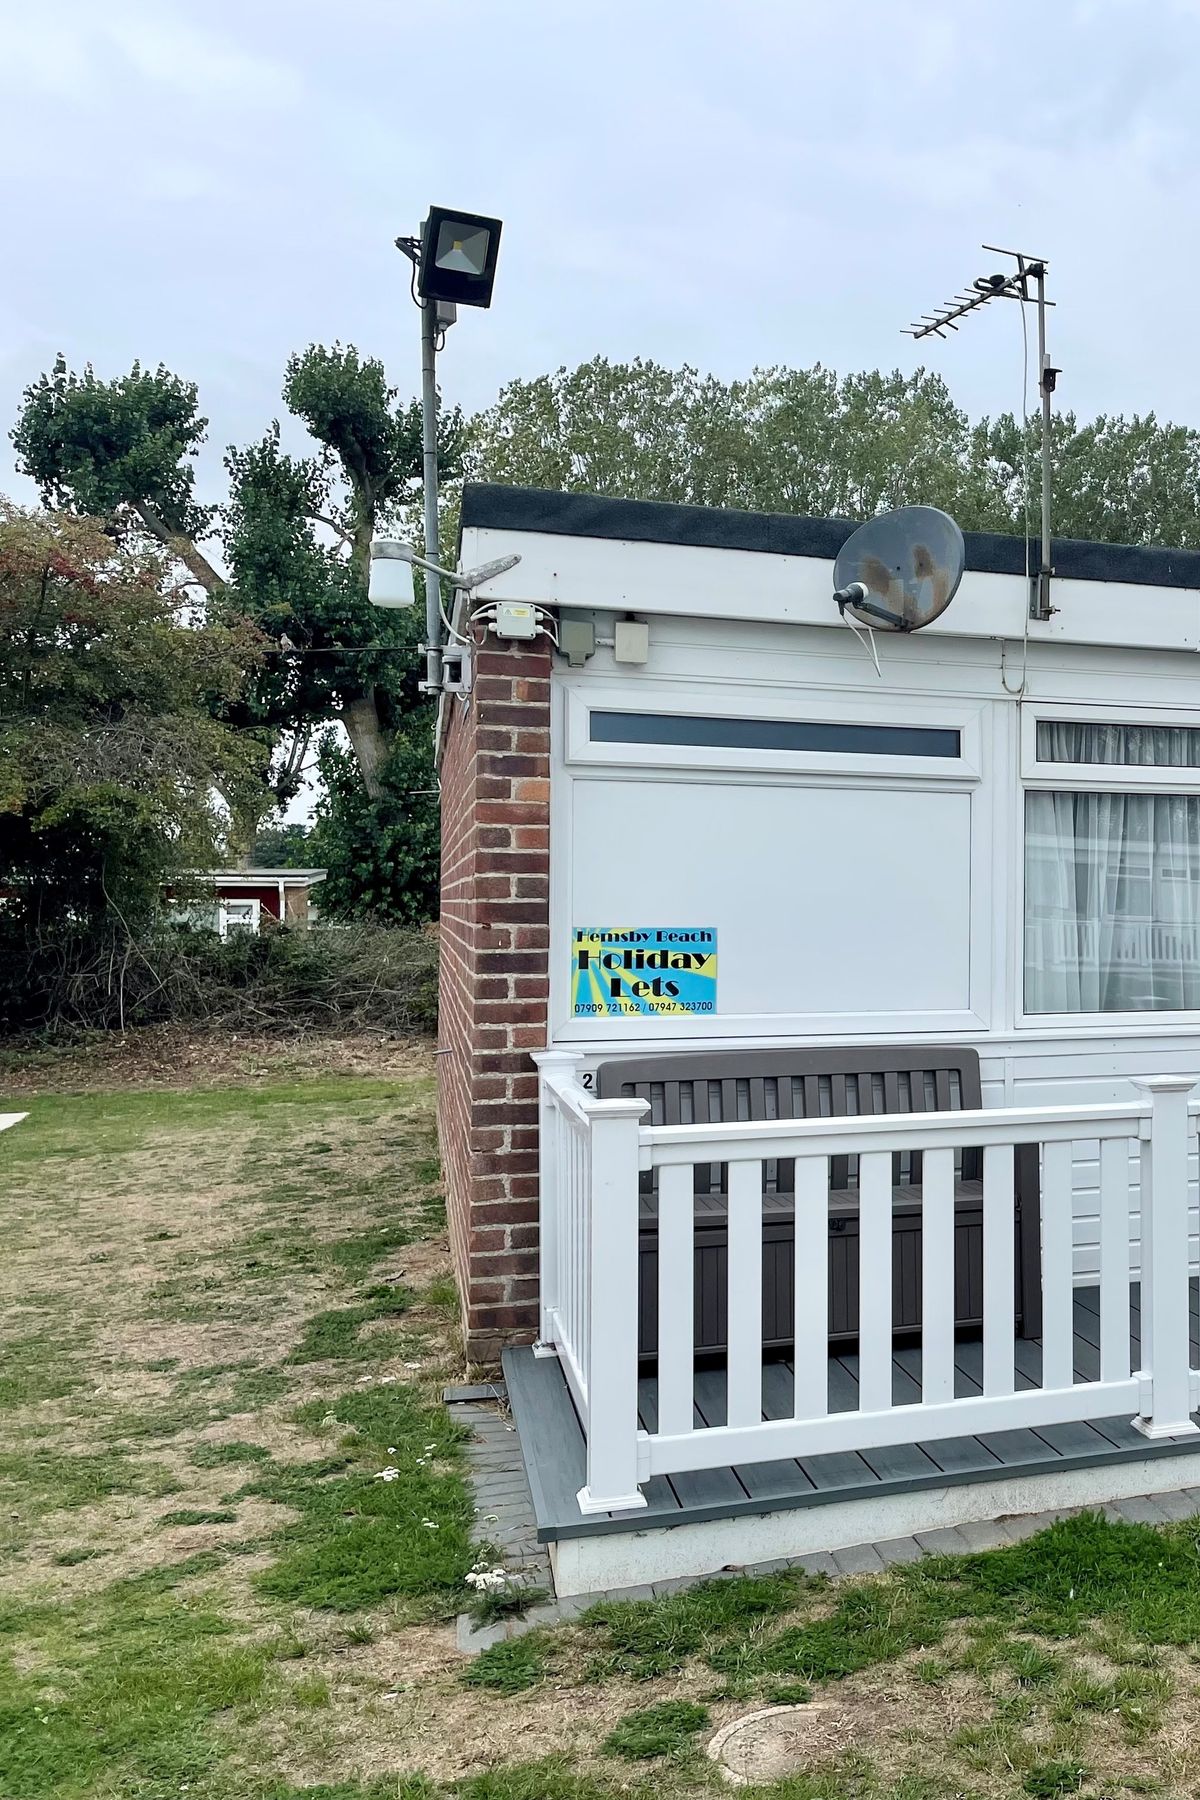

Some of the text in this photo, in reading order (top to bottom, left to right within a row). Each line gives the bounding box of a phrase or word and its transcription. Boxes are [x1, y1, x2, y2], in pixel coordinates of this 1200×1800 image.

[576, 930, 712, 943] Hemsby Beach
[578, 949, 712, 970] Holiday
[610, 976, 680, 998] Lets
[574, 1003, 603, 1013] 07909
[607, 1002, 641, 1012] 721162
[648, 1002, 676, 1012] 07947
[680, 1001, 713, 1011] 323700
